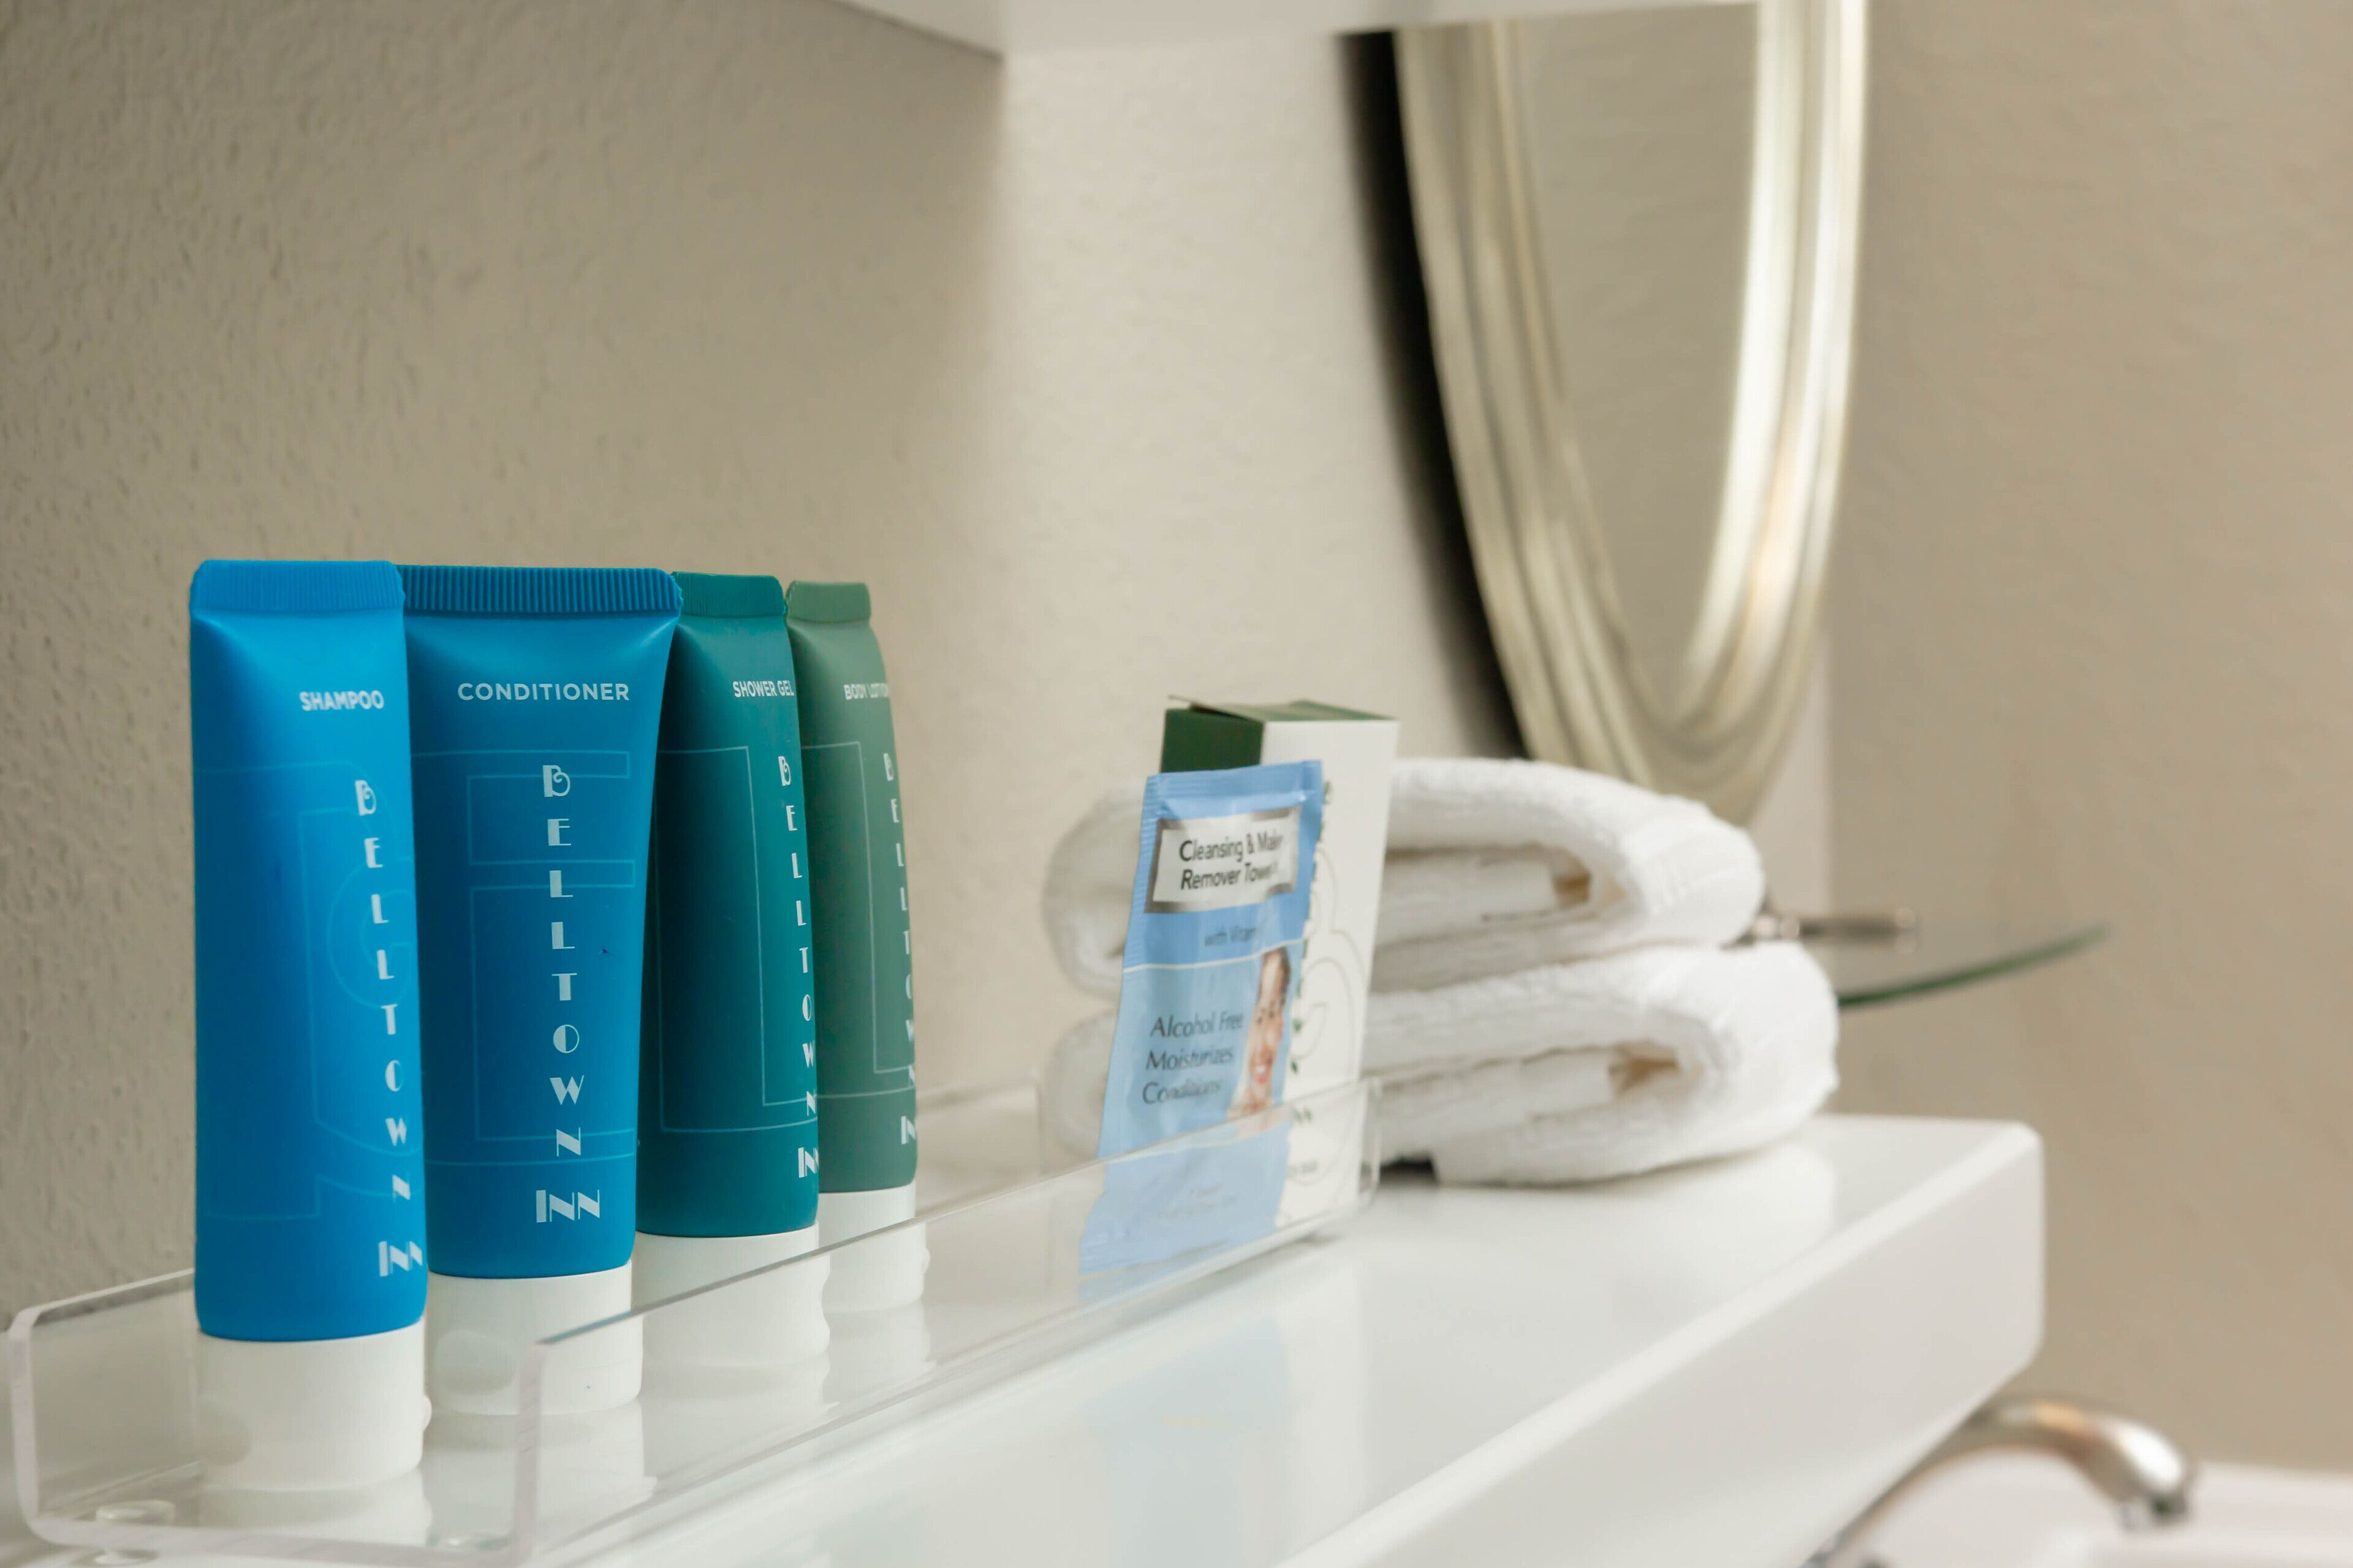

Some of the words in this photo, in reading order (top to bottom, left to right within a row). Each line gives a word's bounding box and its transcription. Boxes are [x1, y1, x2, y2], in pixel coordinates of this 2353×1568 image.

[299, 690, 384, 711] SHAMPOO
[457, 682, 630, 702] CONDITIONER
[732, 680, 777, 698] SHOWER
[777, 680, 795, 697] GEL
[843, 684, 867, 700] BODY
[1179, 836, 1243, 862] Cleansing
[1180, 868, 1241, 890] Remover
[778, 756, 817, 1117] BELLTOWN
[542, 764, 585, 1157] BELLTOWN
[355, 779, 411, 1201] BELLTOWN
[1150, 1012, 1216, 1038] Alcohol
[1219, 1010, 1244, 1031] Free
[901, 1115, 917, 1145] IN
[536, 1189, 600, 1223] INN
[378, 1241, 423, 1277] INN
